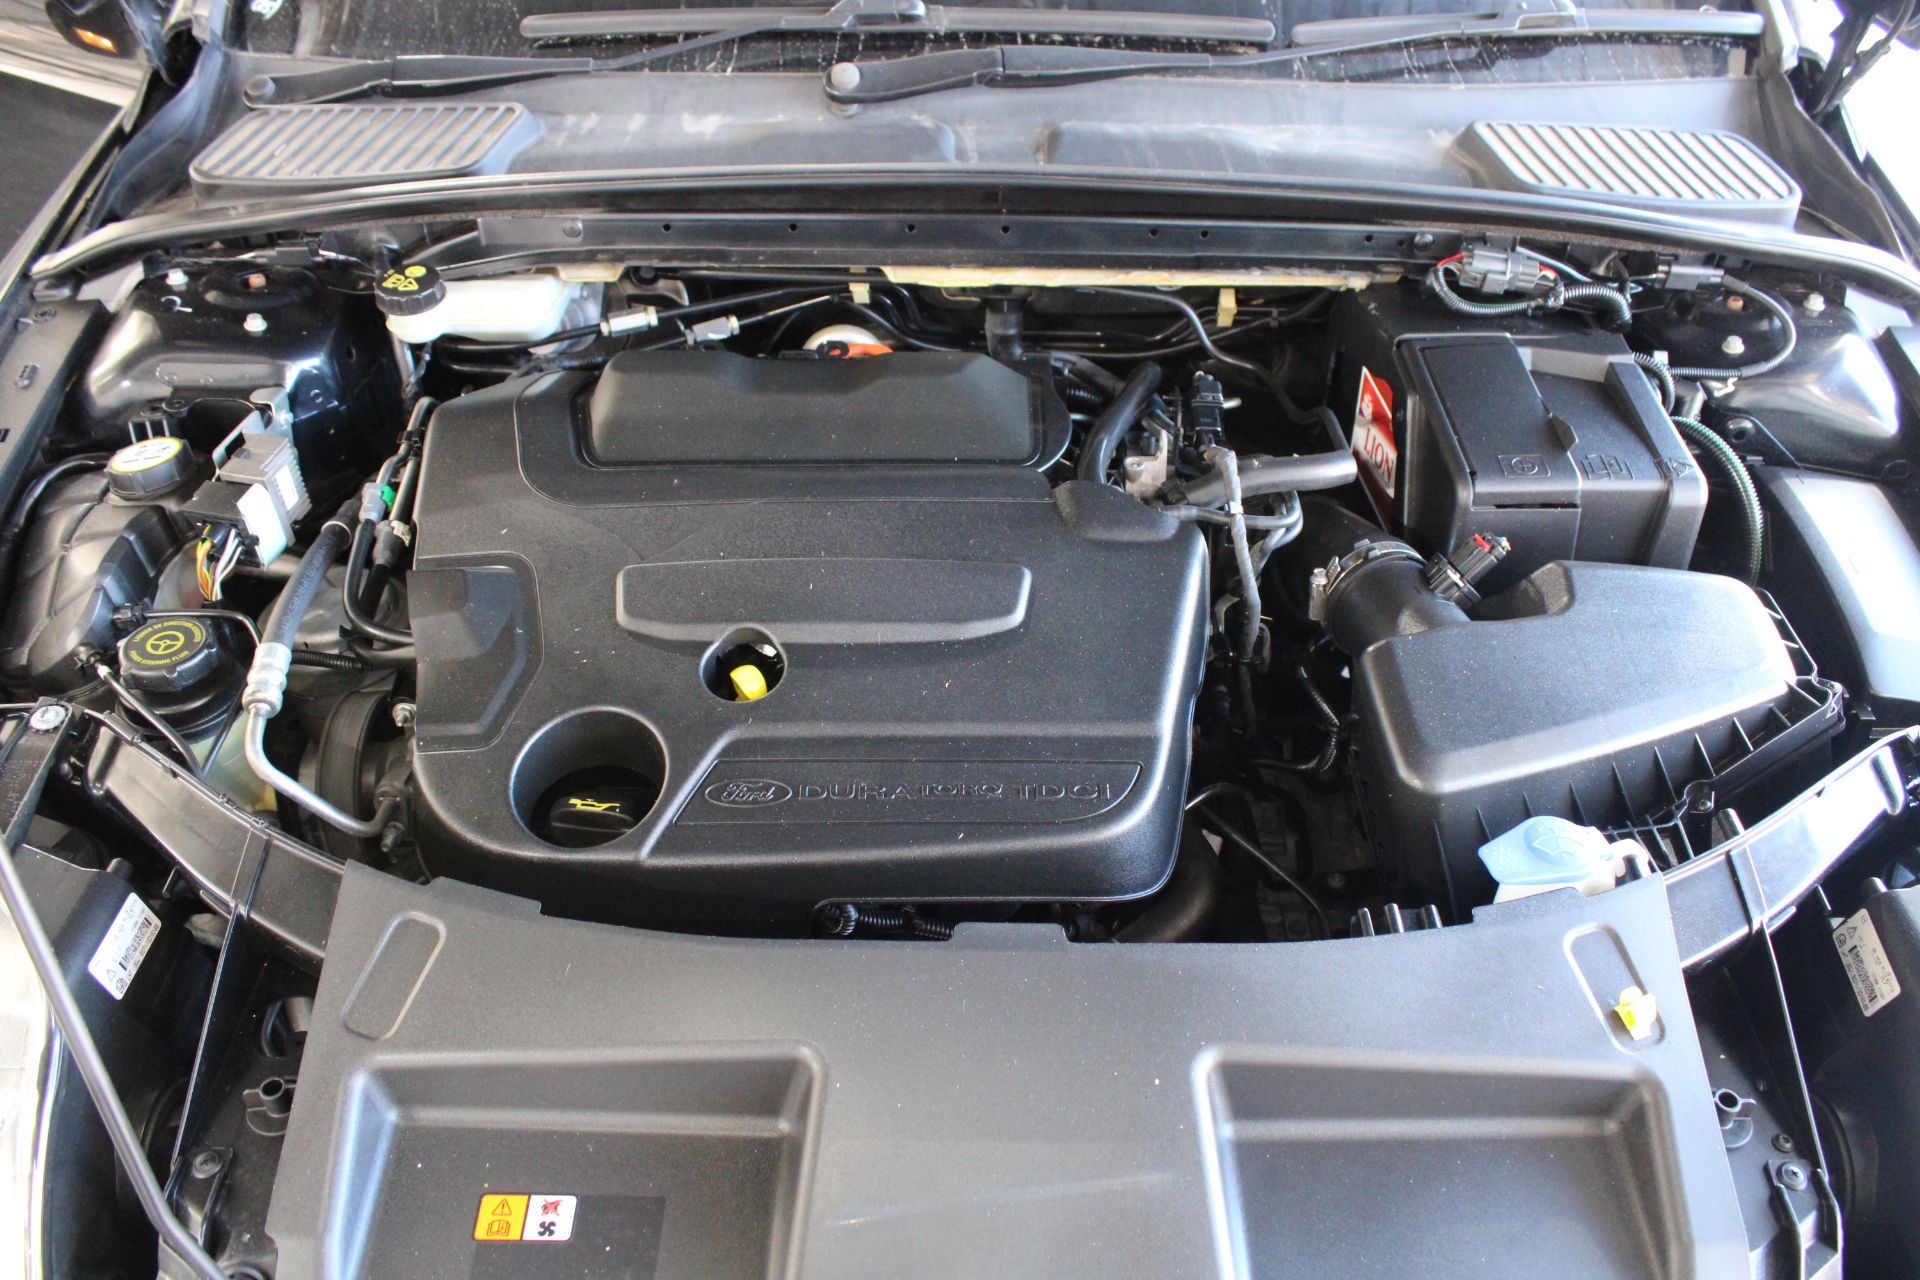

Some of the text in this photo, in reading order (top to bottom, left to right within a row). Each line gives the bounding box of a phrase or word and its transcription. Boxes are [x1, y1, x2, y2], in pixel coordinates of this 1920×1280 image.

[1364, 427, 1395, 483] LION
[172, 650, 190, 661] FLUID
[798, 782, 1003, 800] DURATORQ
